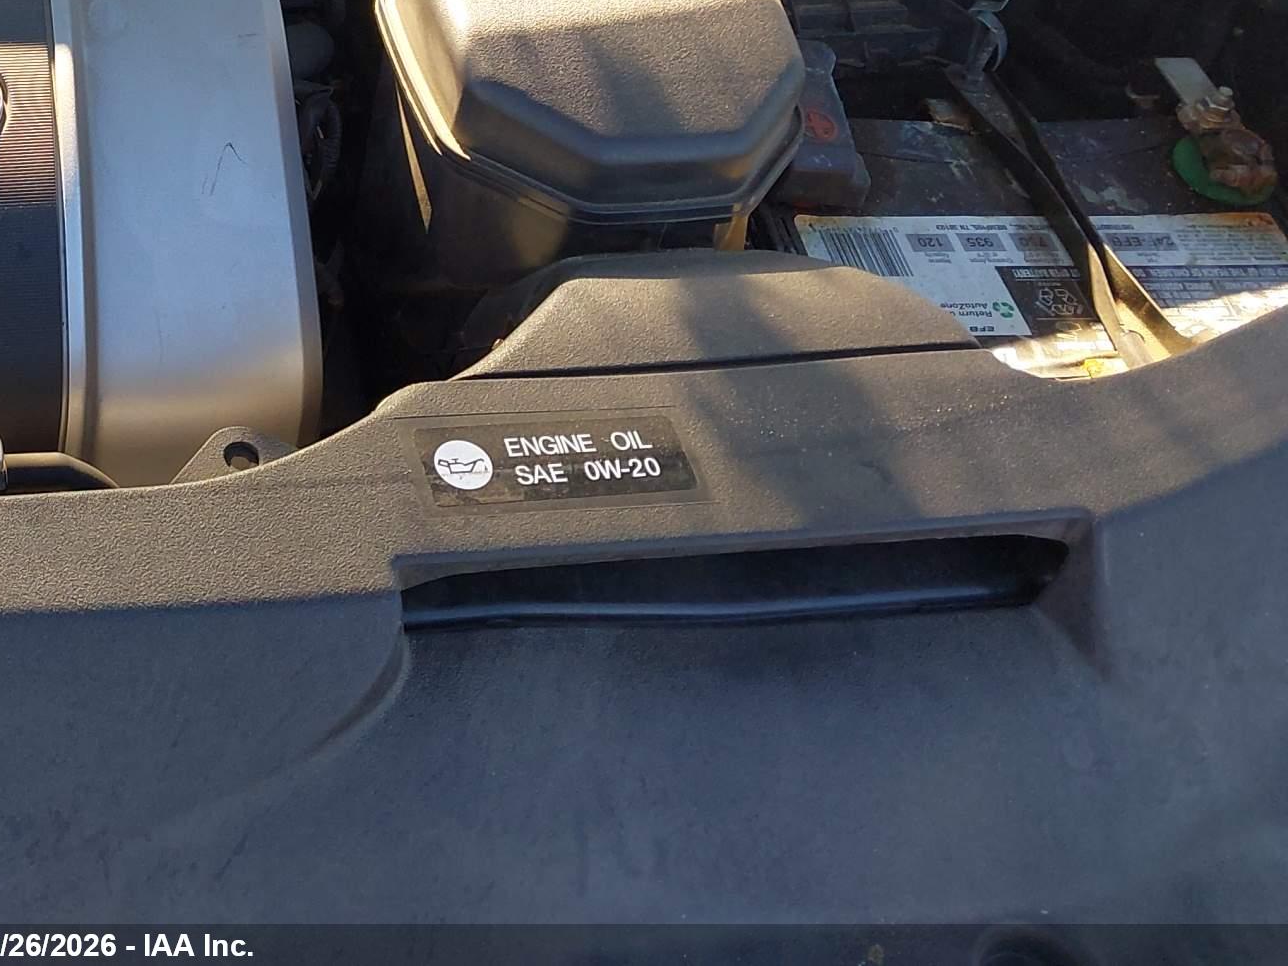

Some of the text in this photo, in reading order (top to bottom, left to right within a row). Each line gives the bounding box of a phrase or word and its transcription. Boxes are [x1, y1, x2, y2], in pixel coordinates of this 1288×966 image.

[917, 237, 943, 247] 120
[966, 237, 993, 247] 935
[504, 430, 653, 458] ENGINE OIL
[515, 457, 661, 486] SAE 0W-20
